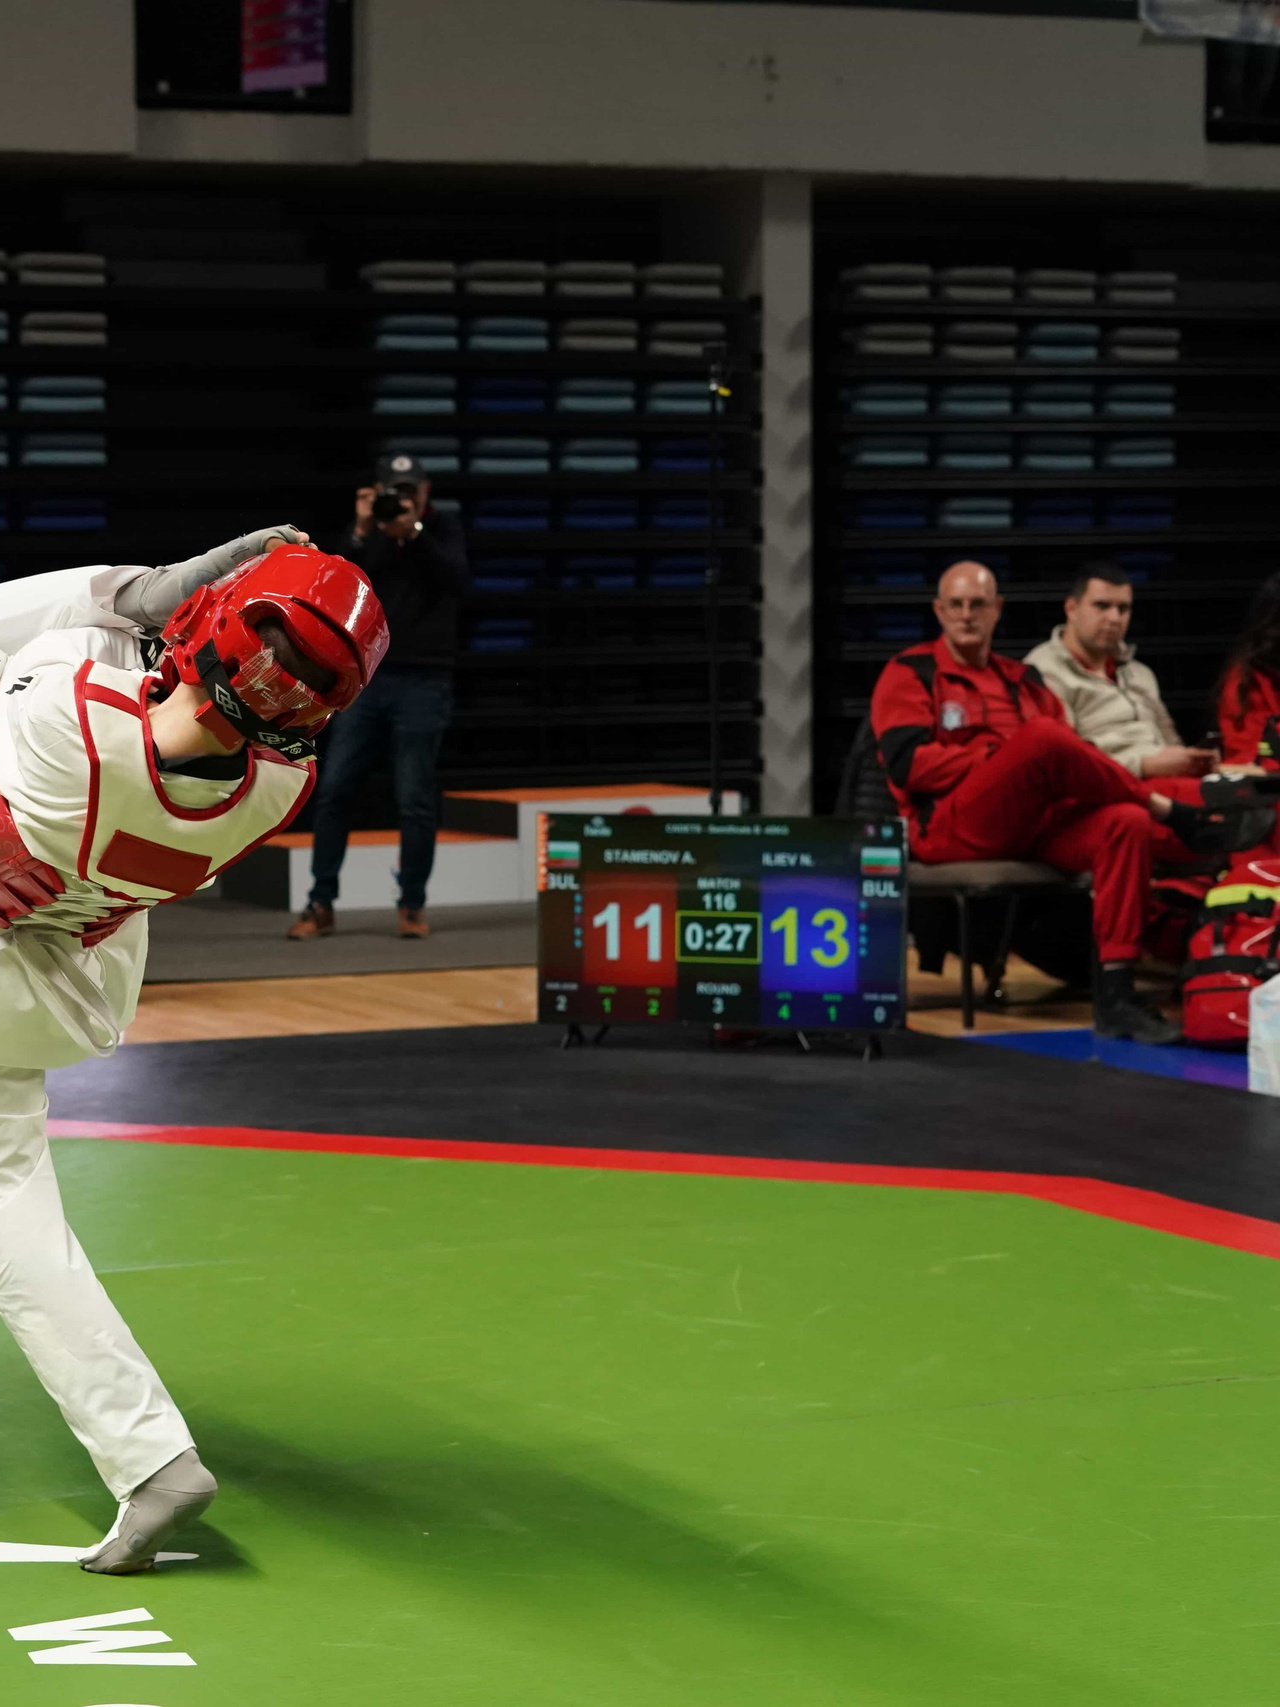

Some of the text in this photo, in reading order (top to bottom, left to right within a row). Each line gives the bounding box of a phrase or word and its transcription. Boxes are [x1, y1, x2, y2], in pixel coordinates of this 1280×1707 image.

[604, 849, 678, 865] STAMENOV
[862, 880, 900, 898] BUL
[702, 892, 737, 911] 116
[592, 902, 662, 962] 11
[684, 922, 752, 952] 0:27
[770, 907, 850, 968] 13
[556, 995, 567, 1011] 2
[602, 998, 611, 1014] 1
[712, 997, 724, 1014] 3
[777, 1004, 790, 1020] 4
[828, 1005, 837, 1022] 1
[873, 1006, 886, 1023] 0
